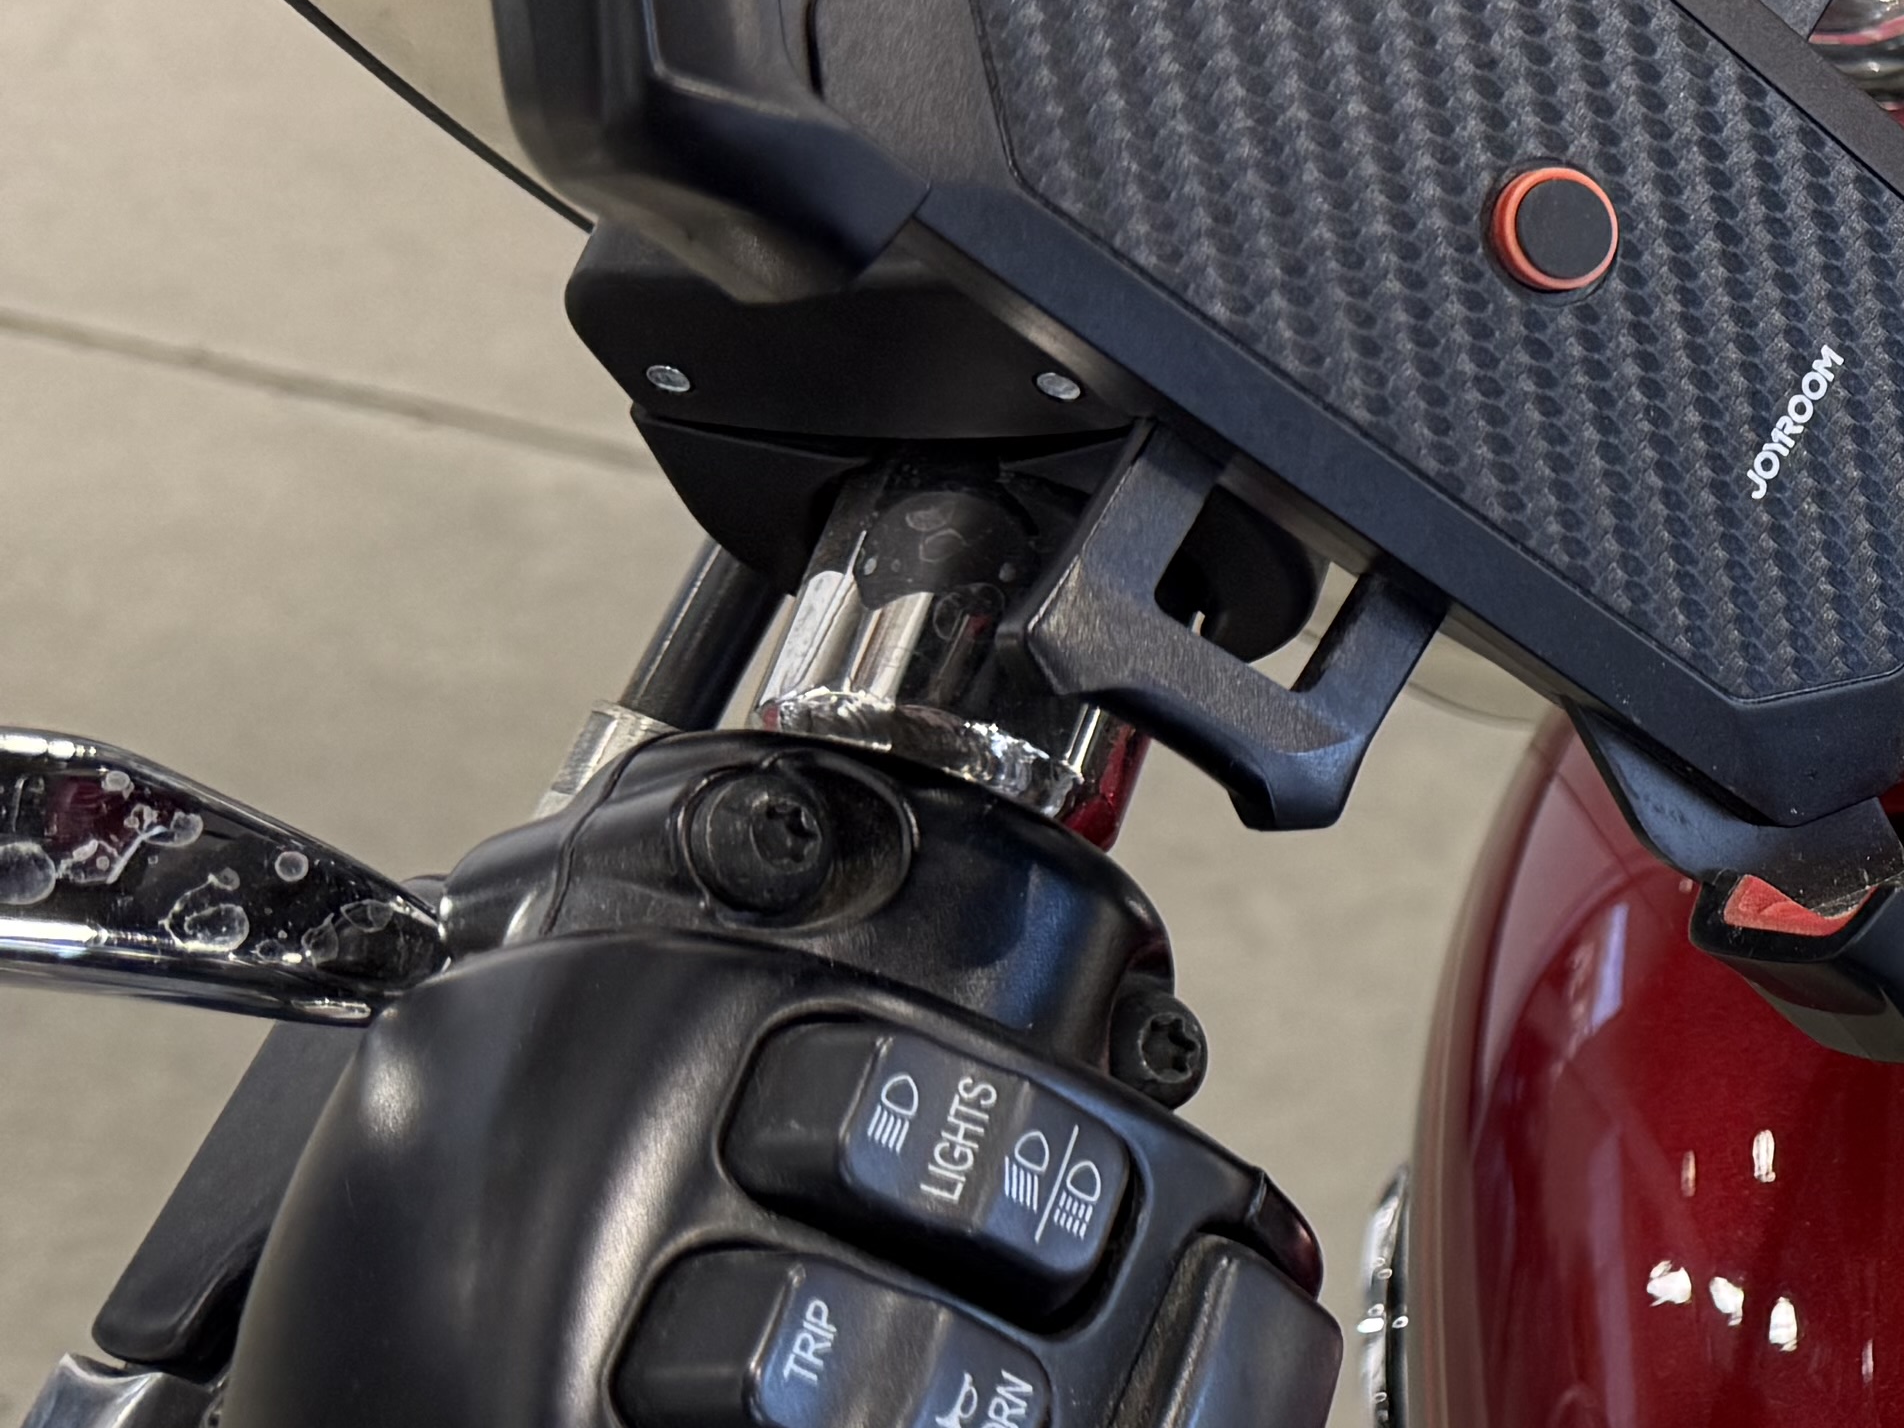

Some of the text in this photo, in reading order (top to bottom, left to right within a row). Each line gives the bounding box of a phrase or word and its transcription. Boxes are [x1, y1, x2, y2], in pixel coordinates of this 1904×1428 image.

[1746, 344, 1845, 500] JOYROOM
[919, 1076, 998, 1205] LIGHTS
[783, 1299, 838, 1386] TRIP
